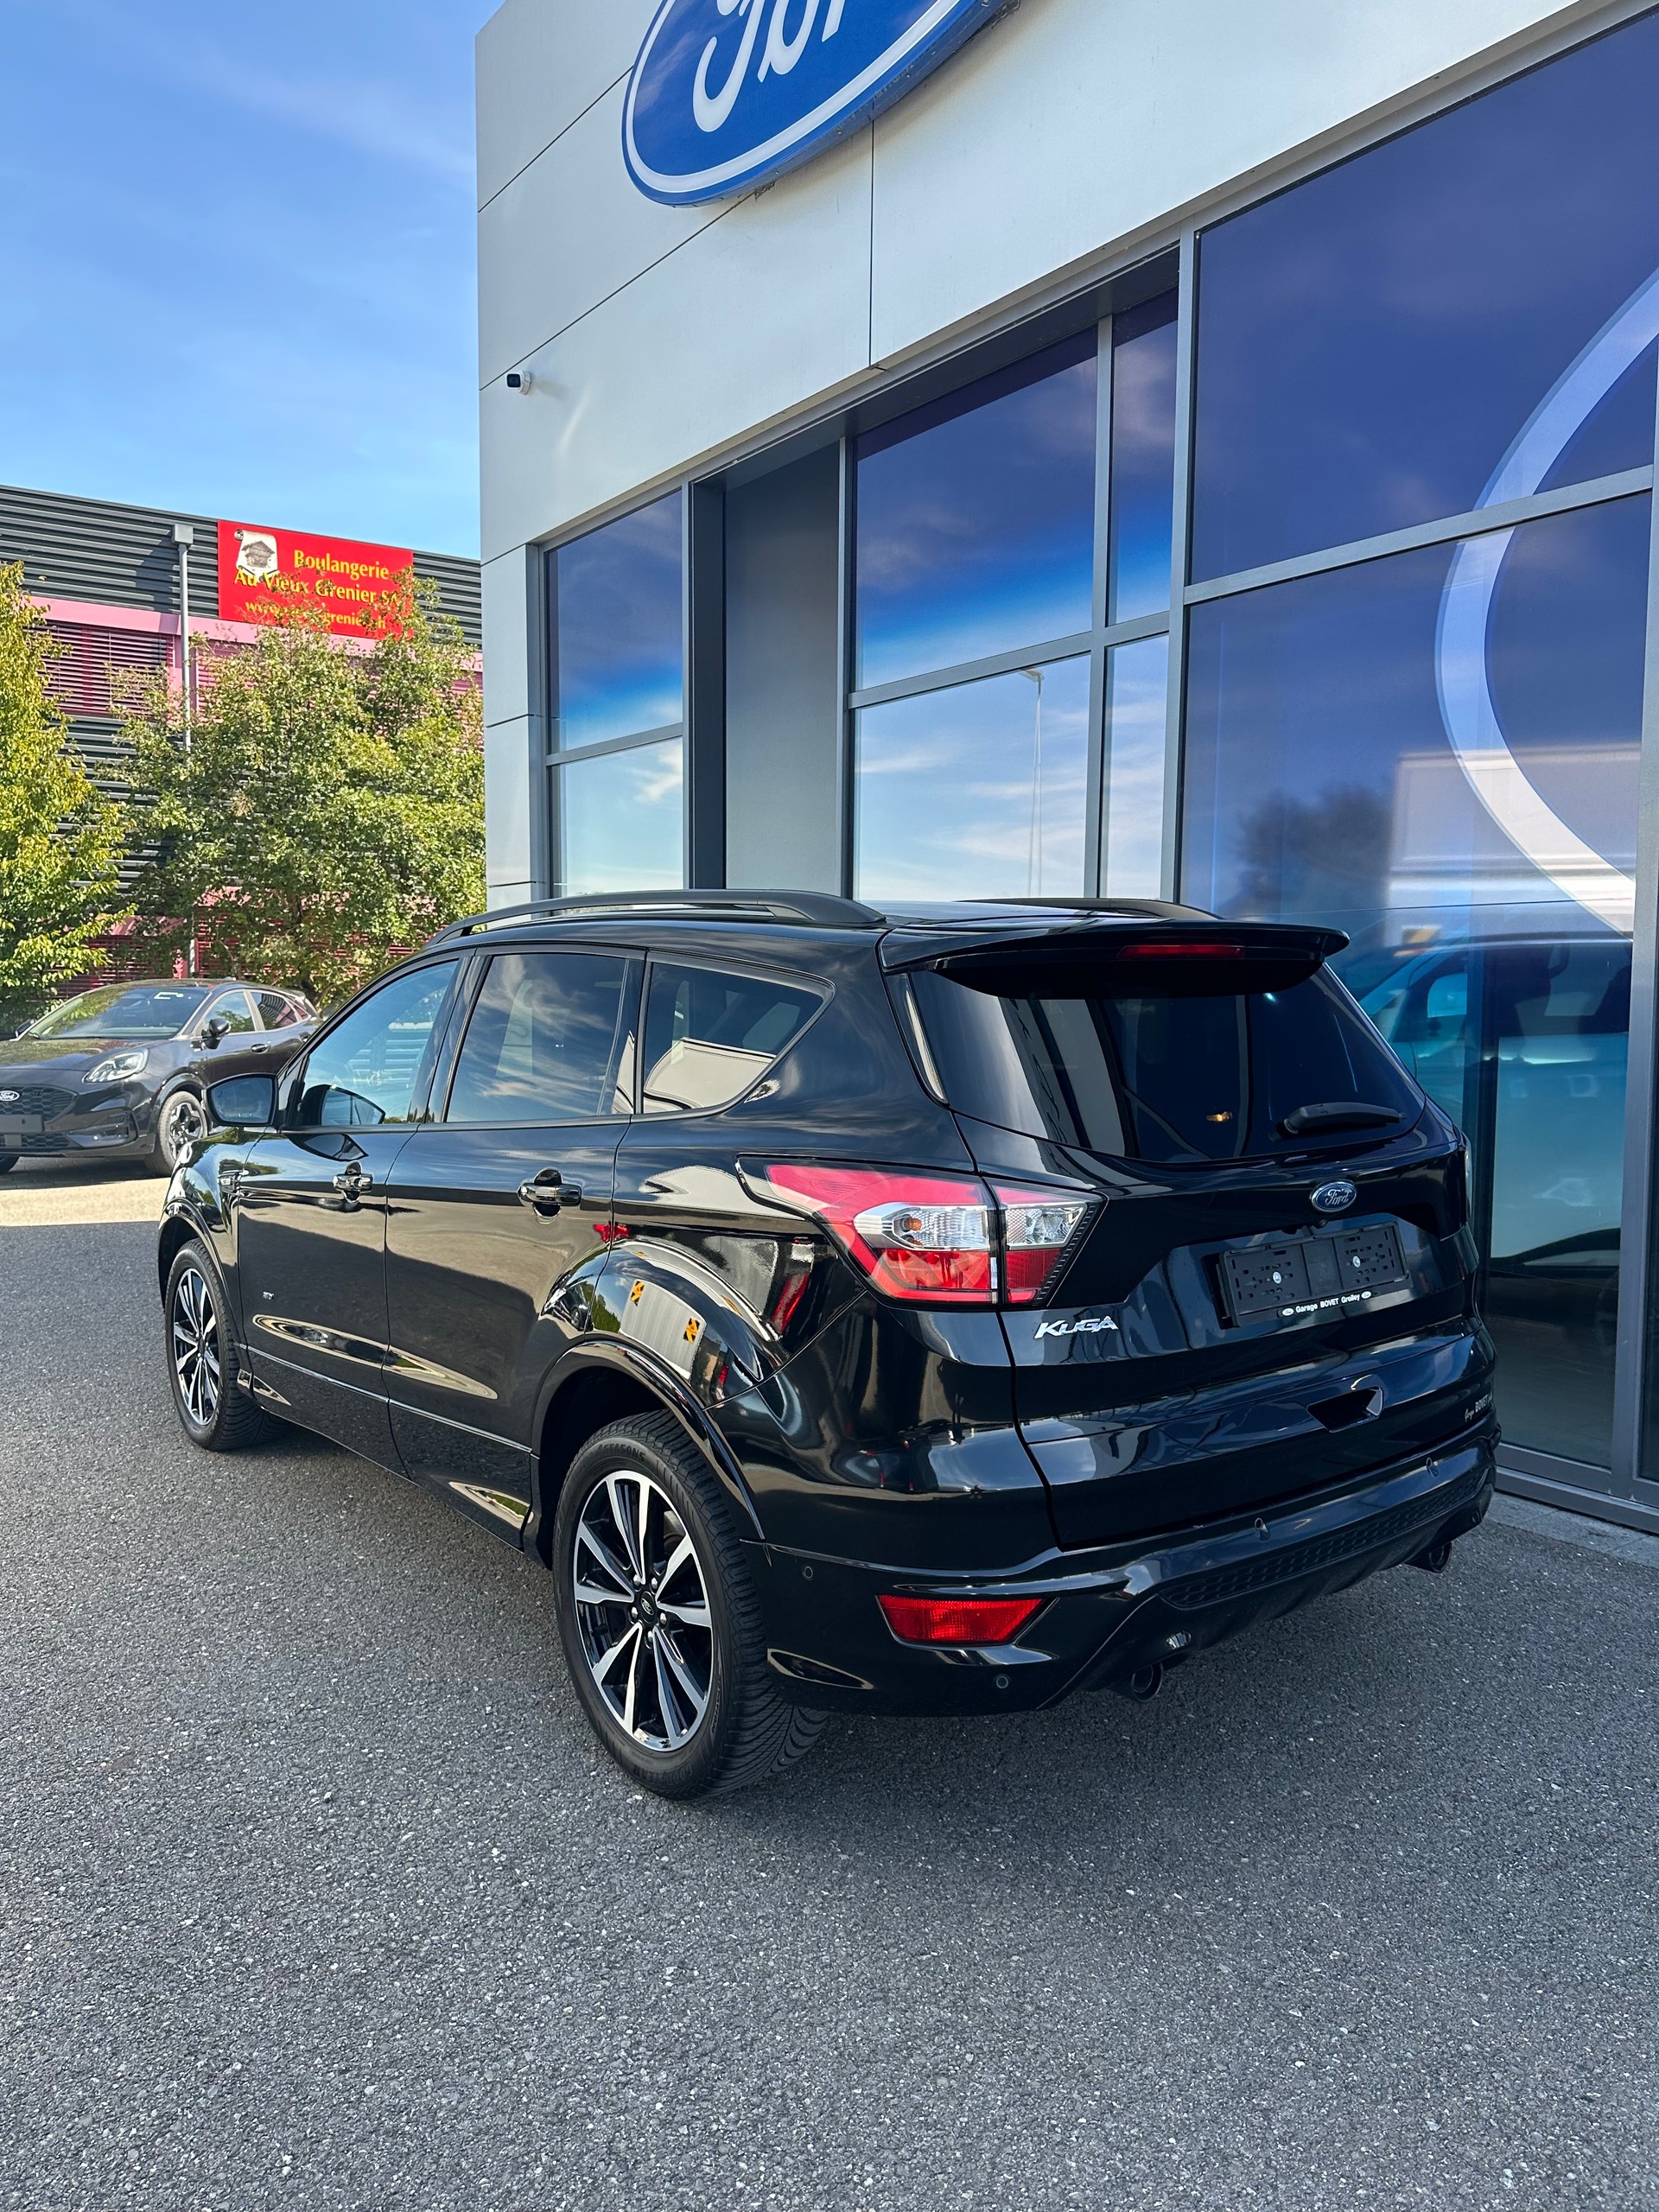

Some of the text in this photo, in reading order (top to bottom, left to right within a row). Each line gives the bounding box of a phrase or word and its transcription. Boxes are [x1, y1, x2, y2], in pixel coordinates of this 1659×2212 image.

[294, 549, 390, 581] Boulangerie
[233, 568, 257, 587] Au
[315, 579, 378, 603] Grenier
[1325, 1188, 1353, 1205] Ford
[1295, 1304, 1319, 1314] Garage
[1319, 1298, 1339, 1308] BOVET
[1341, 1294, 1361, 1304] Grolley
[1034, 1315, 1119, 1339] KUGA
